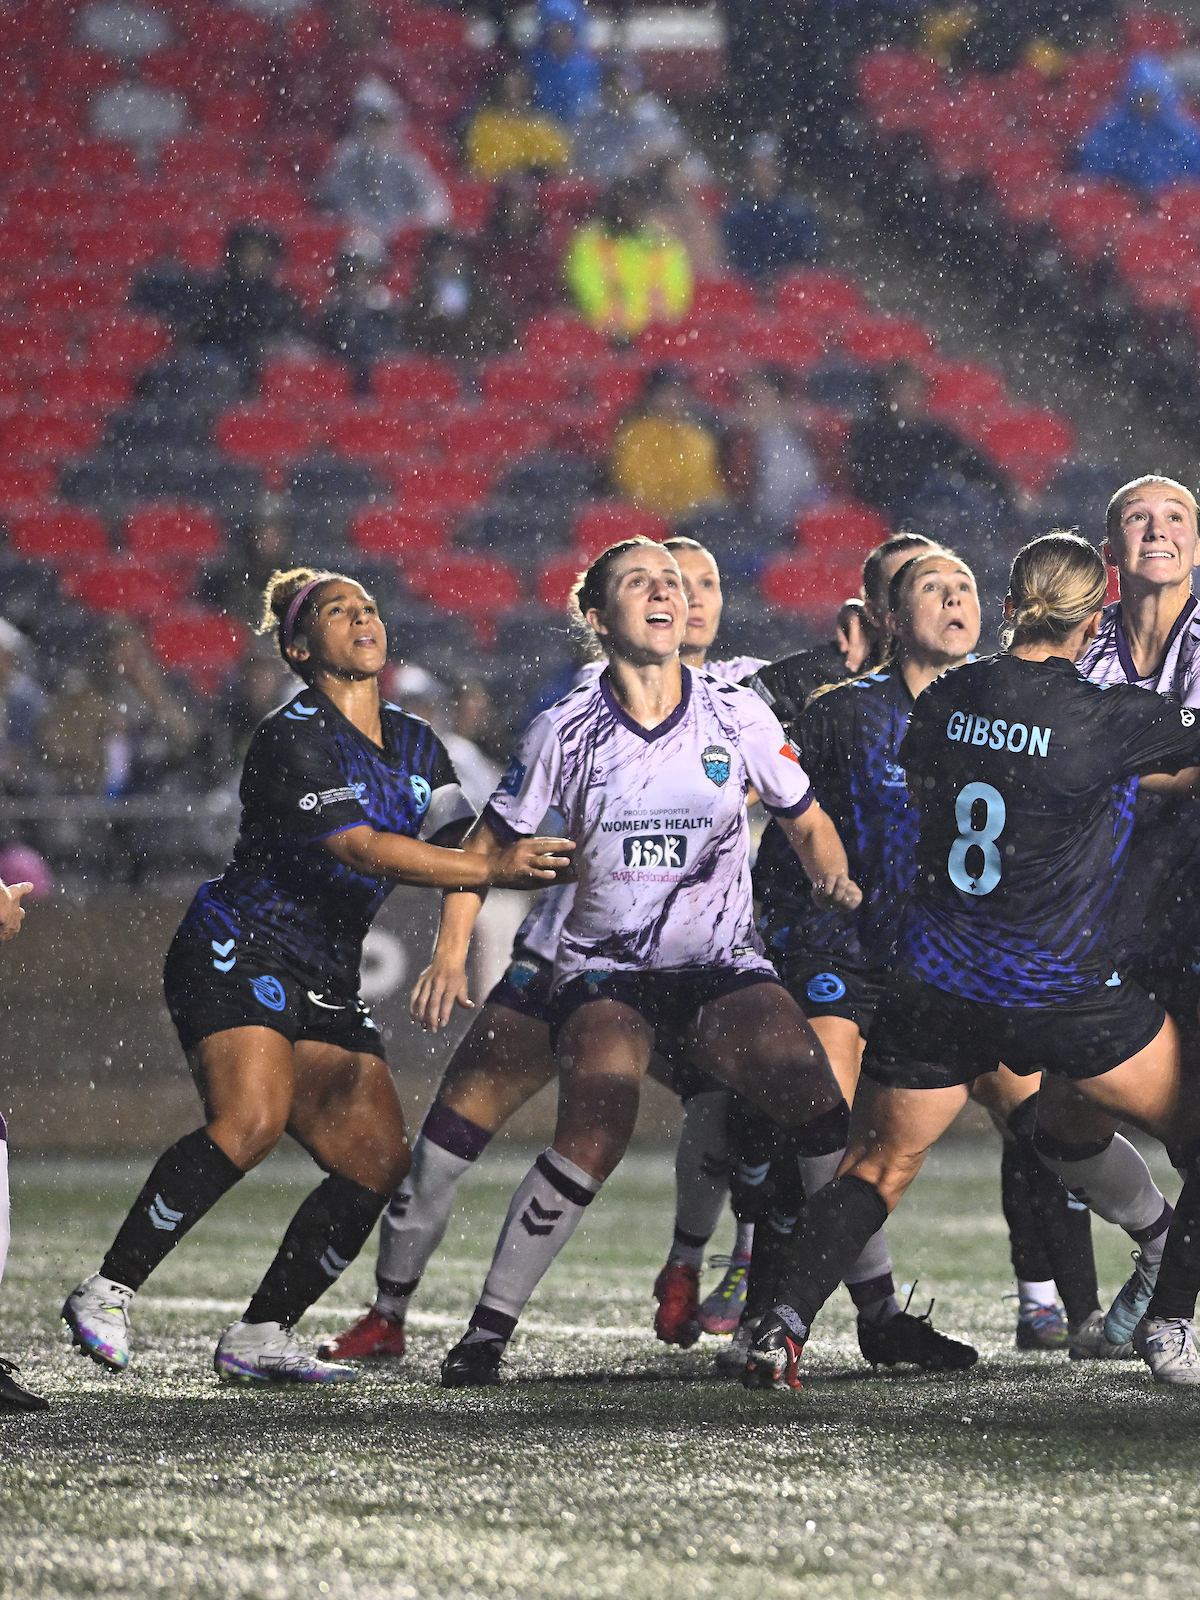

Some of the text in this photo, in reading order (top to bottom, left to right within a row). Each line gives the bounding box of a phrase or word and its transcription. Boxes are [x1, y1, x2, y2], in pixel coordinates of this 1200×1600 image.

[946, 711, 1052, 757] GIBSON
[703, 752, 730, 763] TIDES
[649, 807, 690, 816] SUPPORTER
[601, 817, 713, 832] WOMEN'S HEALTH
[947, 781, 1007, 896] 8
